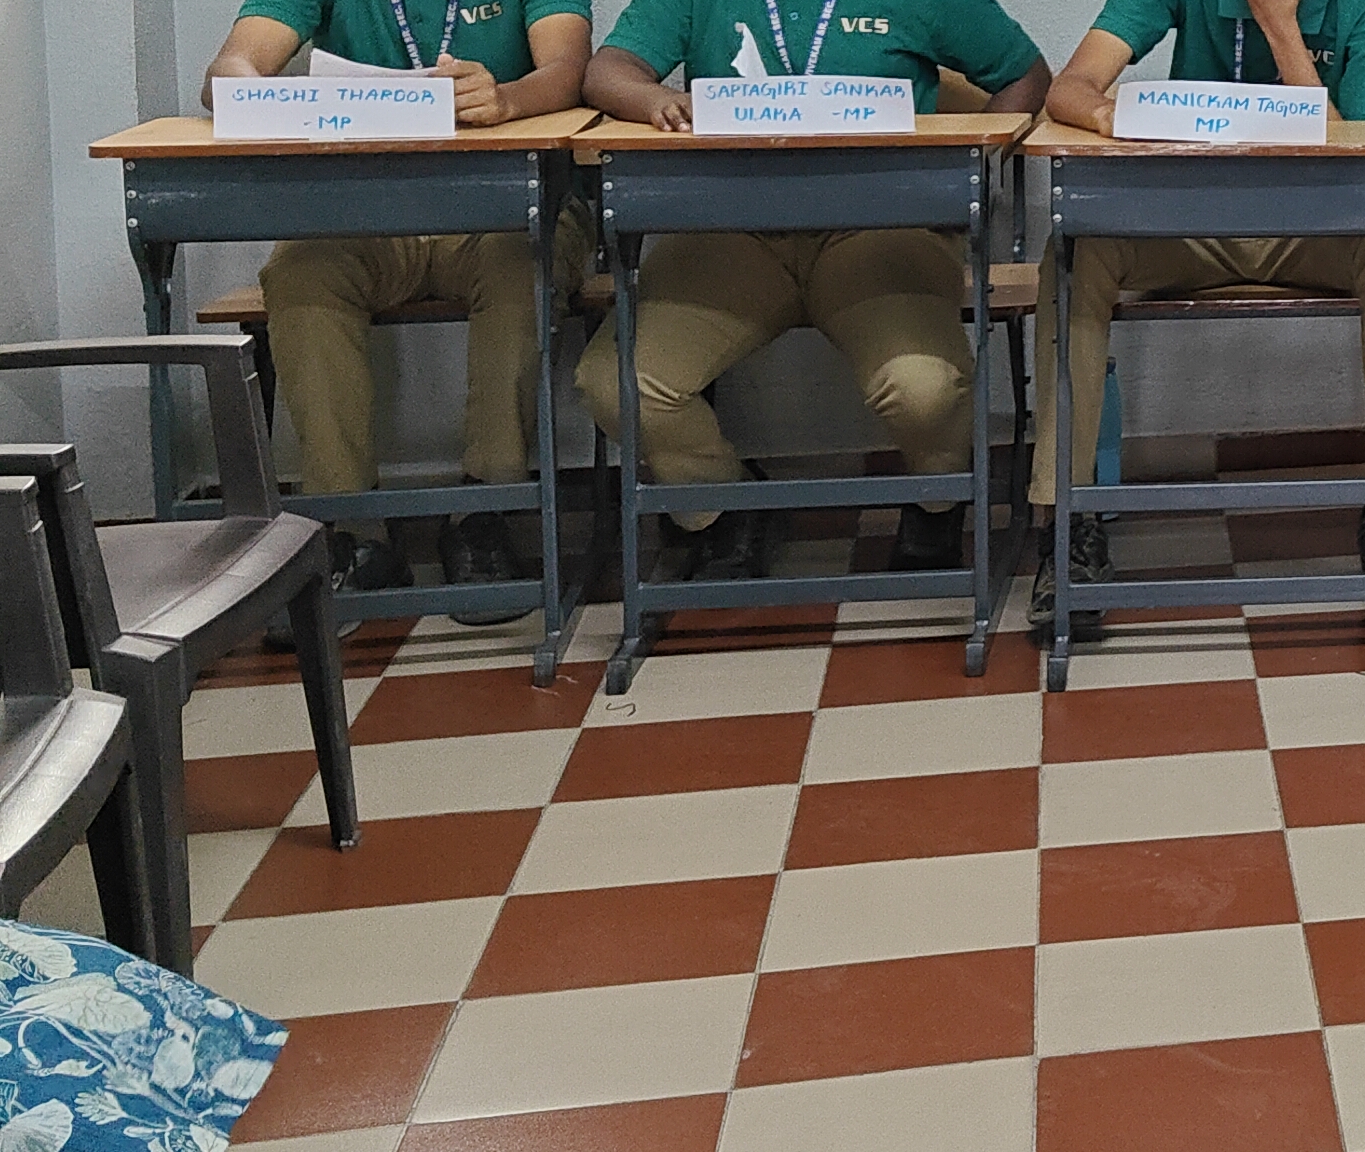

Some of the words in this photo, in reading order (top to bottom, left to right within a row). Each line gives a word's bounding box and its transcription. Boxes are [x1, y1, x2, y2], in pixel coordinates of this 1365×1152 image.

[460, 1, 503, 24] VCS
[841, 17, 889, 34] VCS
[1308, 49, 1335, 65] VC
[232, 88, 319, 102] SHASHI
[705, 81, 808, 100] SAPTAGIRI
[820, 81, 905, 98] SANKAR
[1138, 91, 1250, 111] MANICKAM
[1257, 97, 1322, 117] TAGORE
[734, 107, 802, 122] ULAKA
[1195, 118, 1230, 133] MP
